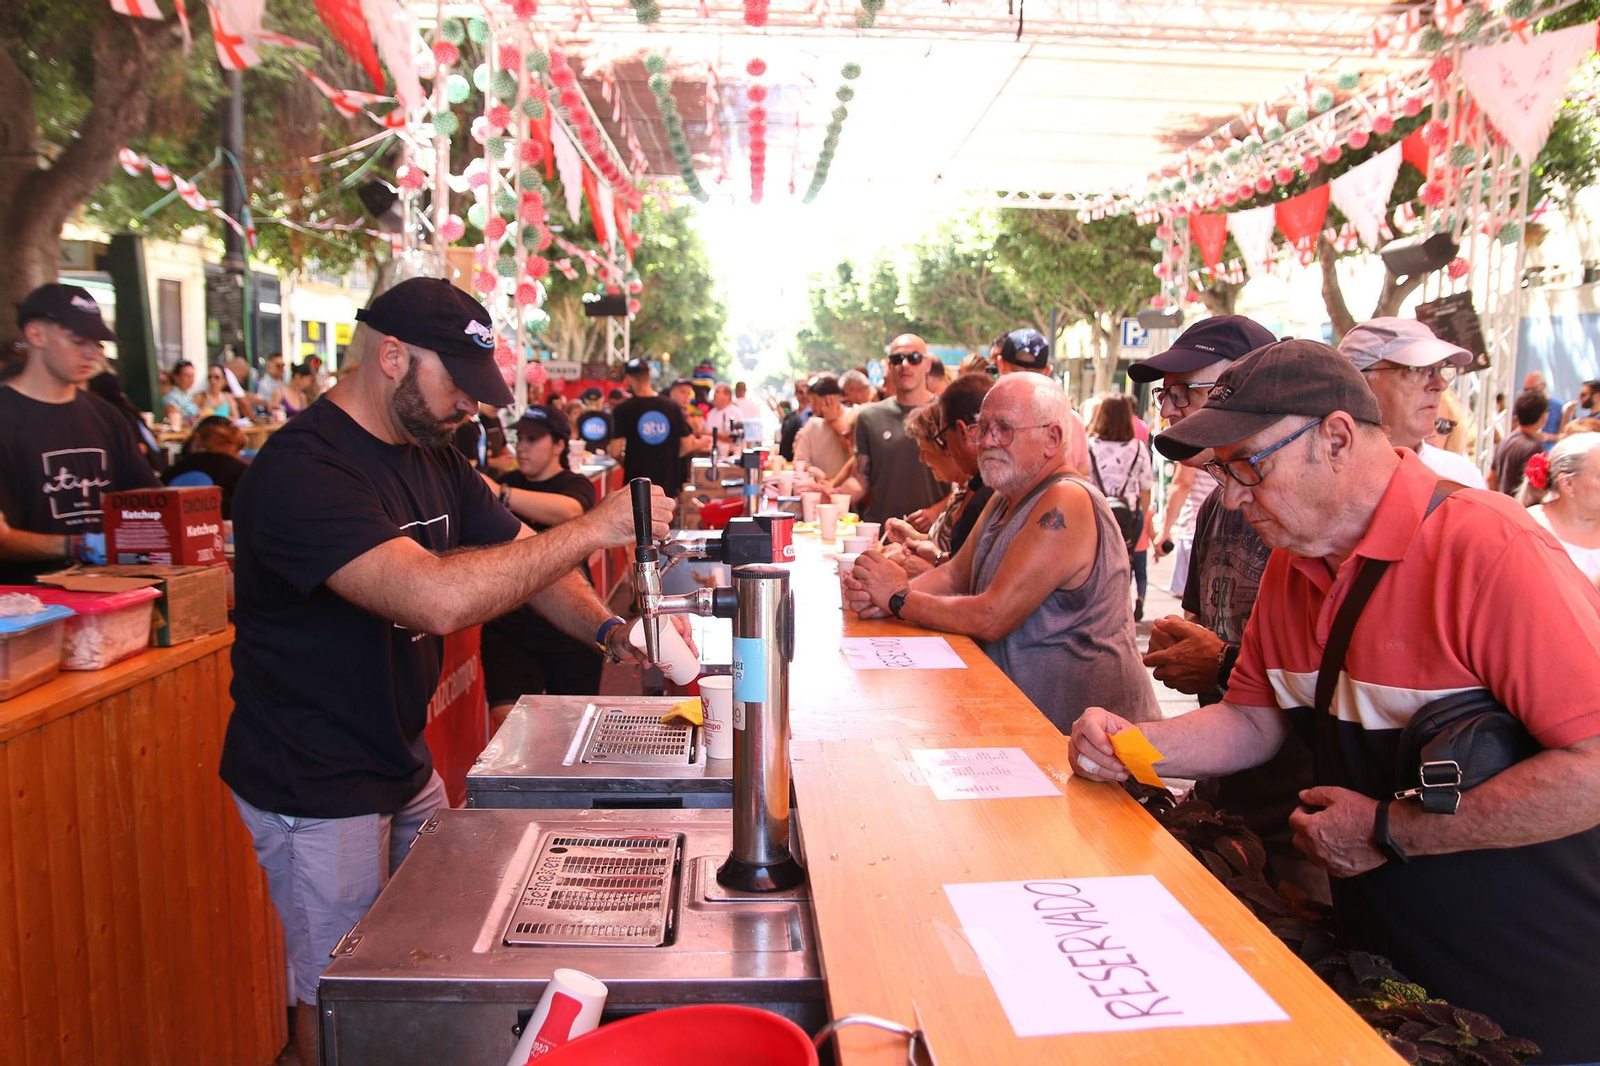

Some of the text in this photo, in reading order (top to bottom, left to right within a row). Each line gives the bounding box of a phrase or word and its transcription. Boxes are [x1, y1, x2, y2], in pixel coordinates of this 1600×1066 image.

[111, 494, 167, 509] DIDILO
[183, 497, 217, 514] DIDILO
[122, 510, 162, 521] Ketchup
[186, 523, 219, 537] Ketchup
[1023, 881, 1184, 1020] RESERVADO
